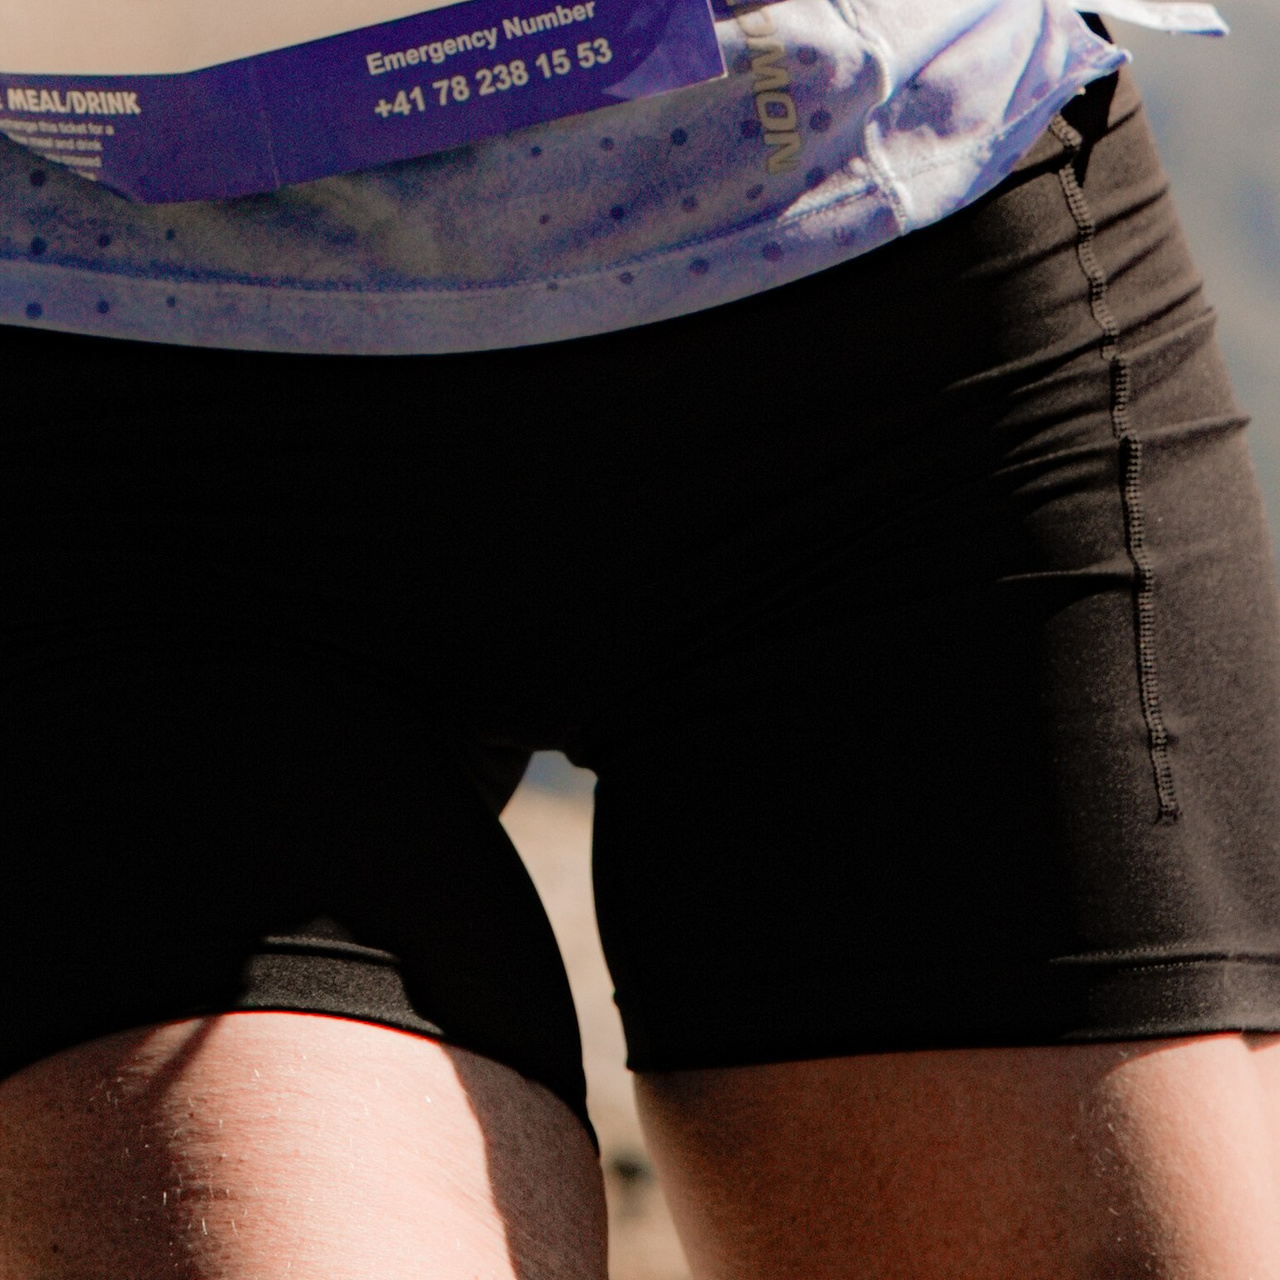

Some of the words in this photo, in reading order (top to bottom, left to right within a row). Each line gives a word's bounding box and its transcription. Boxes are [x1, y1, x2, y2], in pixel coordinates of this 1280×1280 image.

[365, 27, 498, 76] Emergency
[502, 1, 595, 40] Number
[7, 88, 142, 115] MEAL/DRINK
[374, 86, 426, 118] +41
[432, 75, 470, 107] 78
[475, 59, 529, 96] 238
[535, 48, 571, 79] 15
[576, 37, 613, 69] 53
